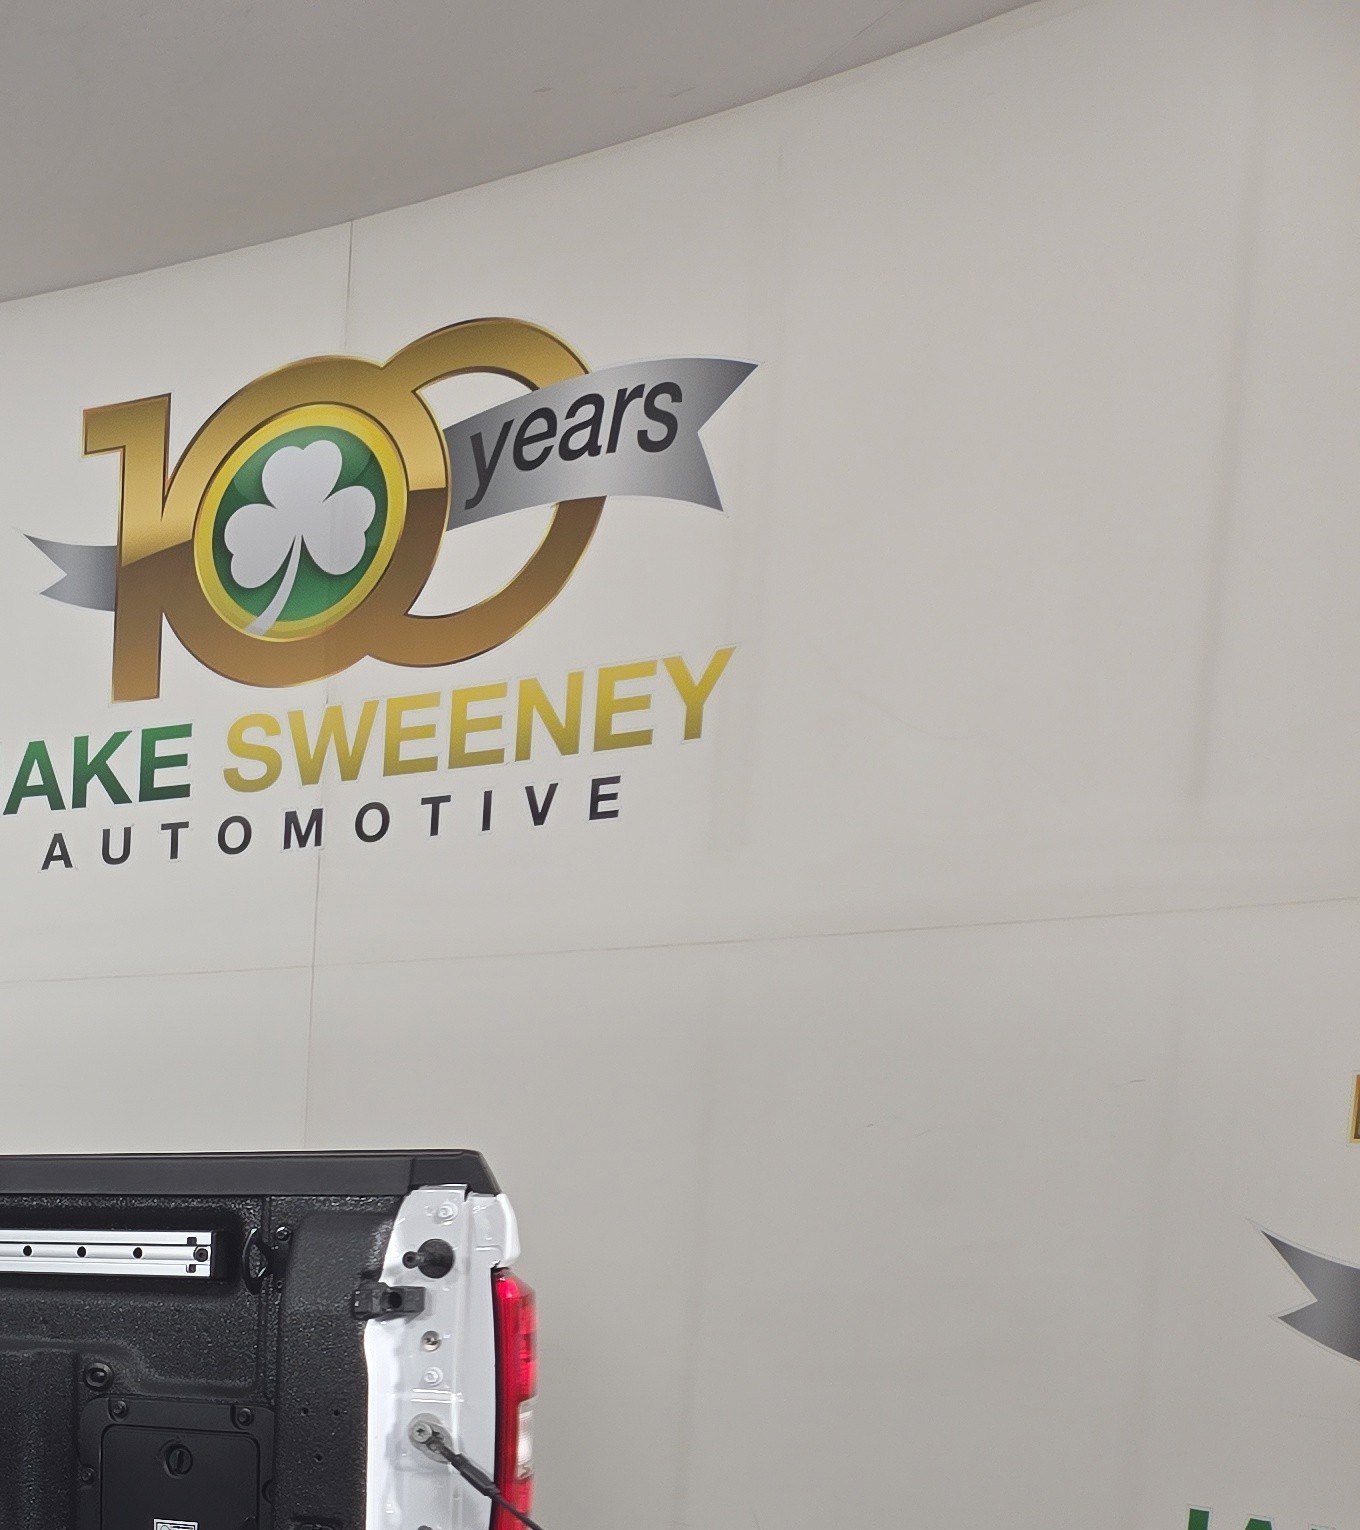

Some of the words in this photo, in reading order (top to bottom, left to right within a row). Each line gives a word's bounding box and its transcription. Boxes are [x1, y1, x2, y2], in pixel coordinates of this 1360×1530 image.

[464, 381, 683, 510] years
[223, 647, 736, 794] SWEENEY
[41, 774, 622, 871] AUTOMOTIVE
